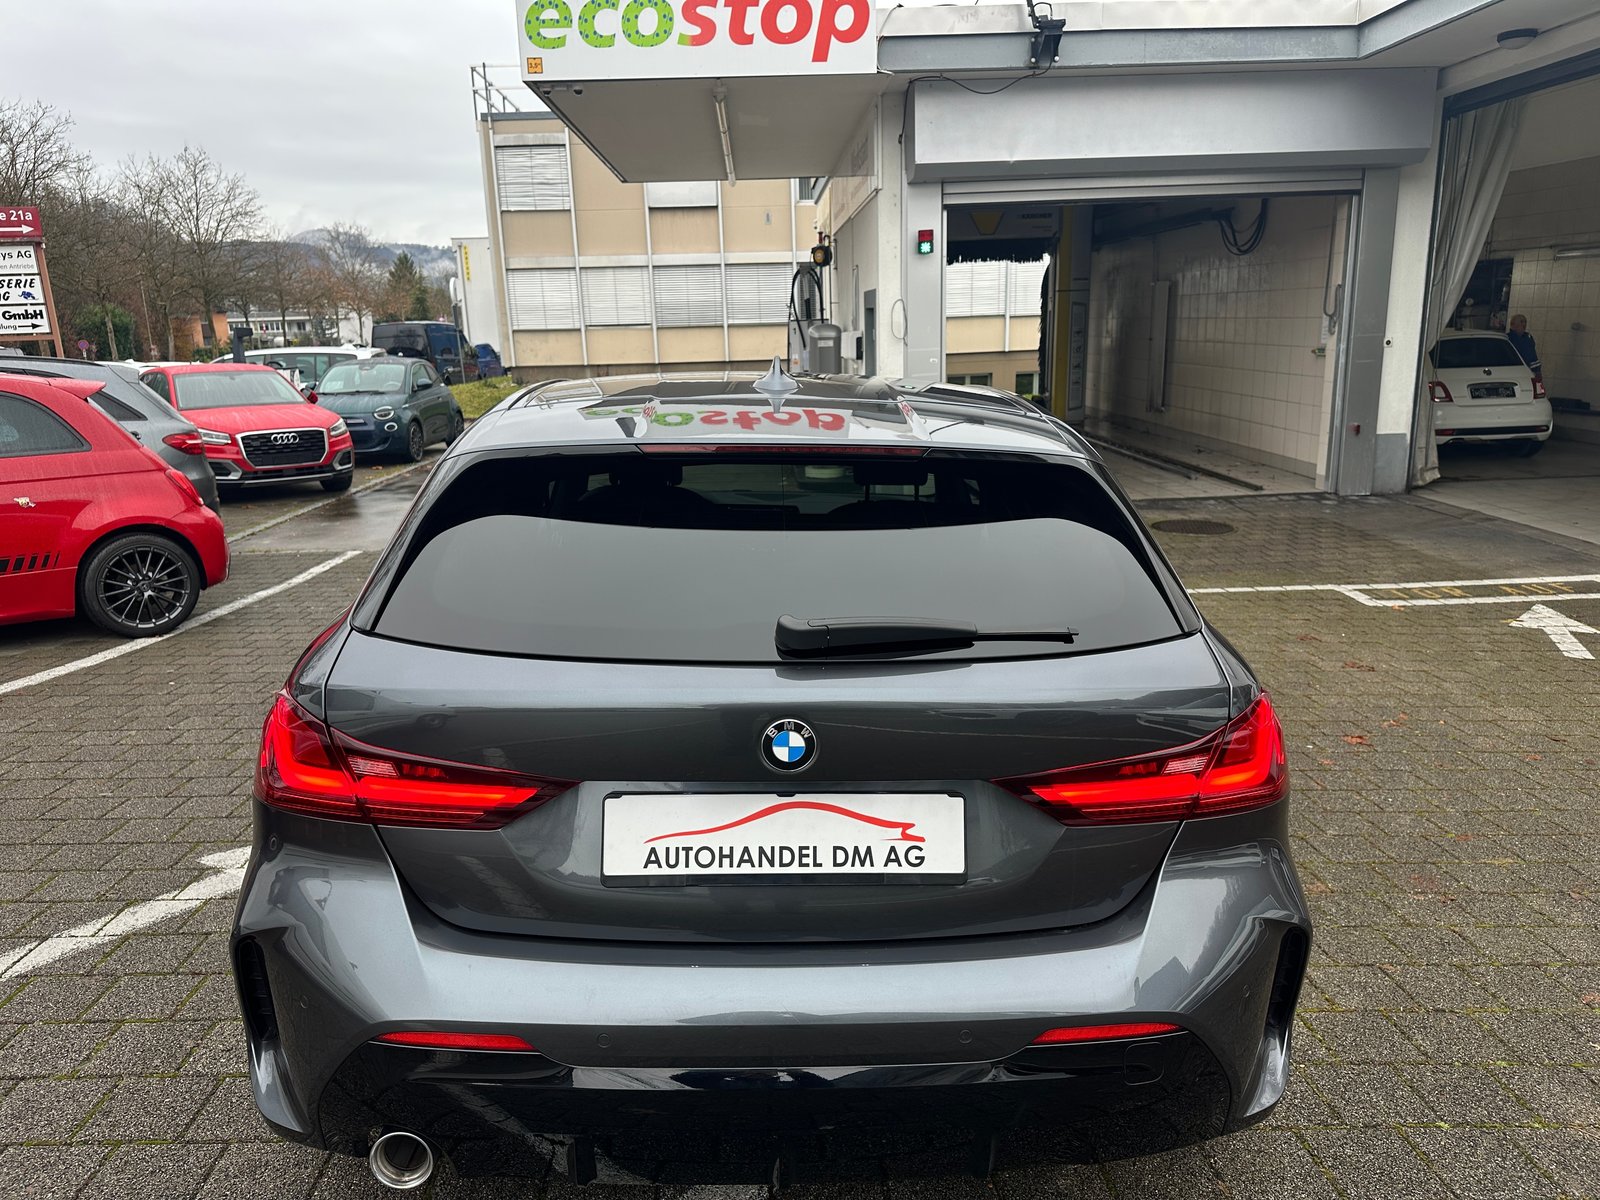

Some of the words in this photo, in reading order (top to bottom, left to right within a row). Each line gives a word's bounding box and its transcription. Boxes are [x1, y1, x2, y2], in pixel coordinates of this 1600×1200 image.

[524, 0, 871, 62] ecostop
[9, 209, 33, 221] 21a
[16, 250, 32, 259] AG
[2, 309, 44, 320] GmbH
[1499, 582, 1574, 597] AUF
[767, 720, 812, 739] BMW
[643, 845, 823, 869] AUTOHANDEL
[832, 845, 875, 869] DM
[883, 845, 926, 869] AG
